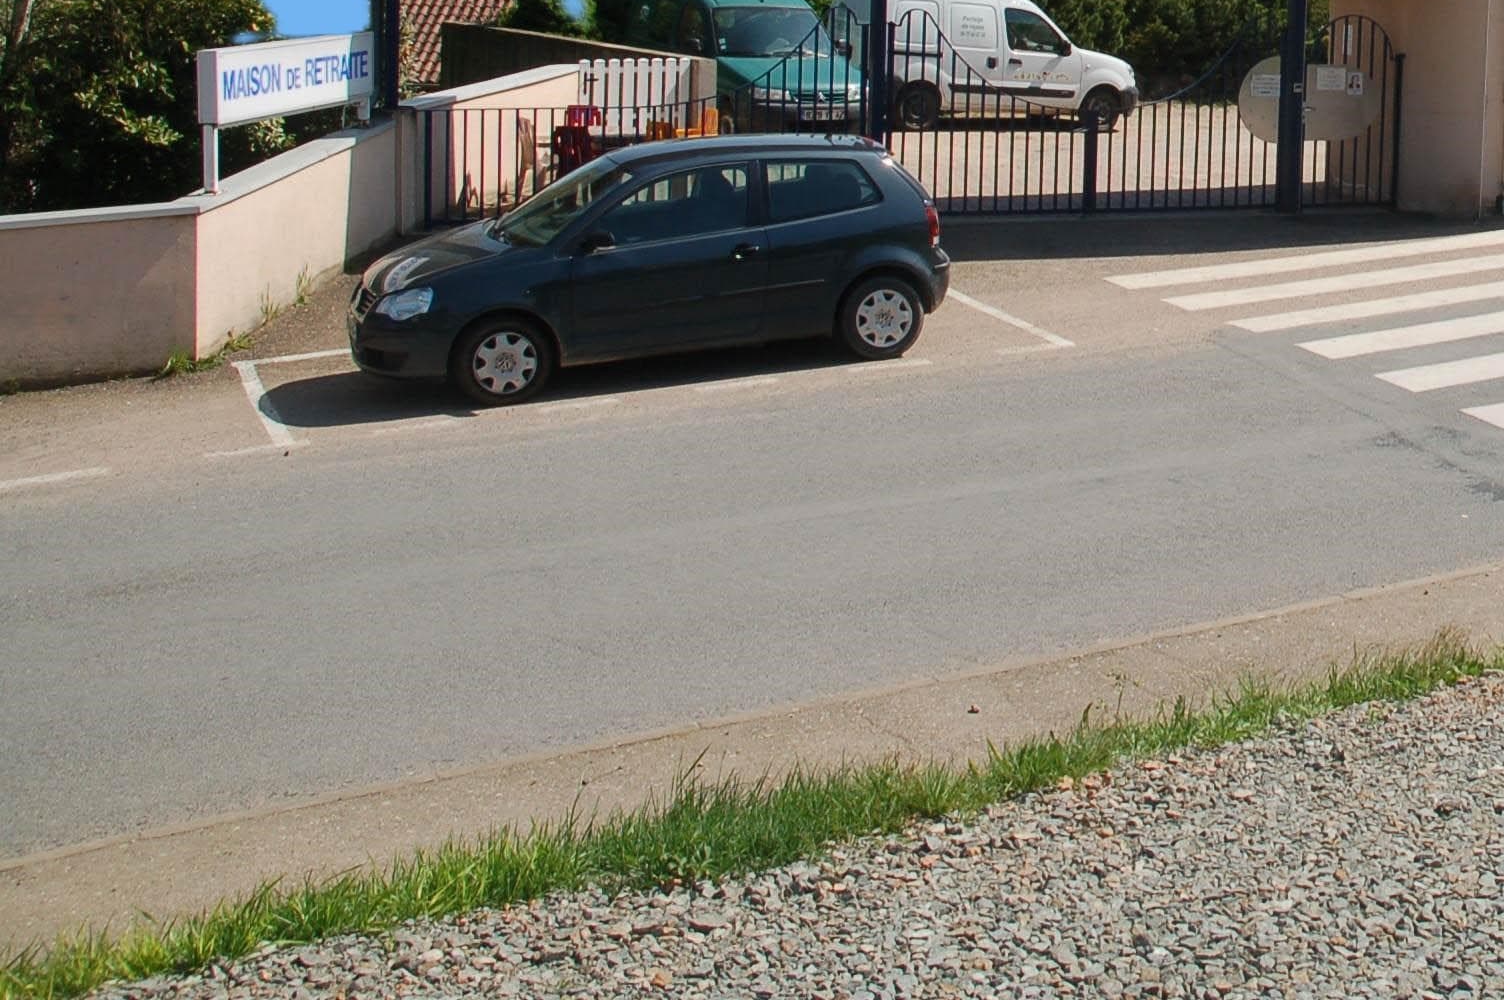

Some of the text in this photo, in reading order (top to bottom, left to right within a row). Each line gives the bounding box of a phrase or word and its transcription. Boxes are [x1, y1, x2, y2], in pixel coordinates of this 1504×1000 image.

[223, 50, 369, 101] MAISON DE RETRAITE
